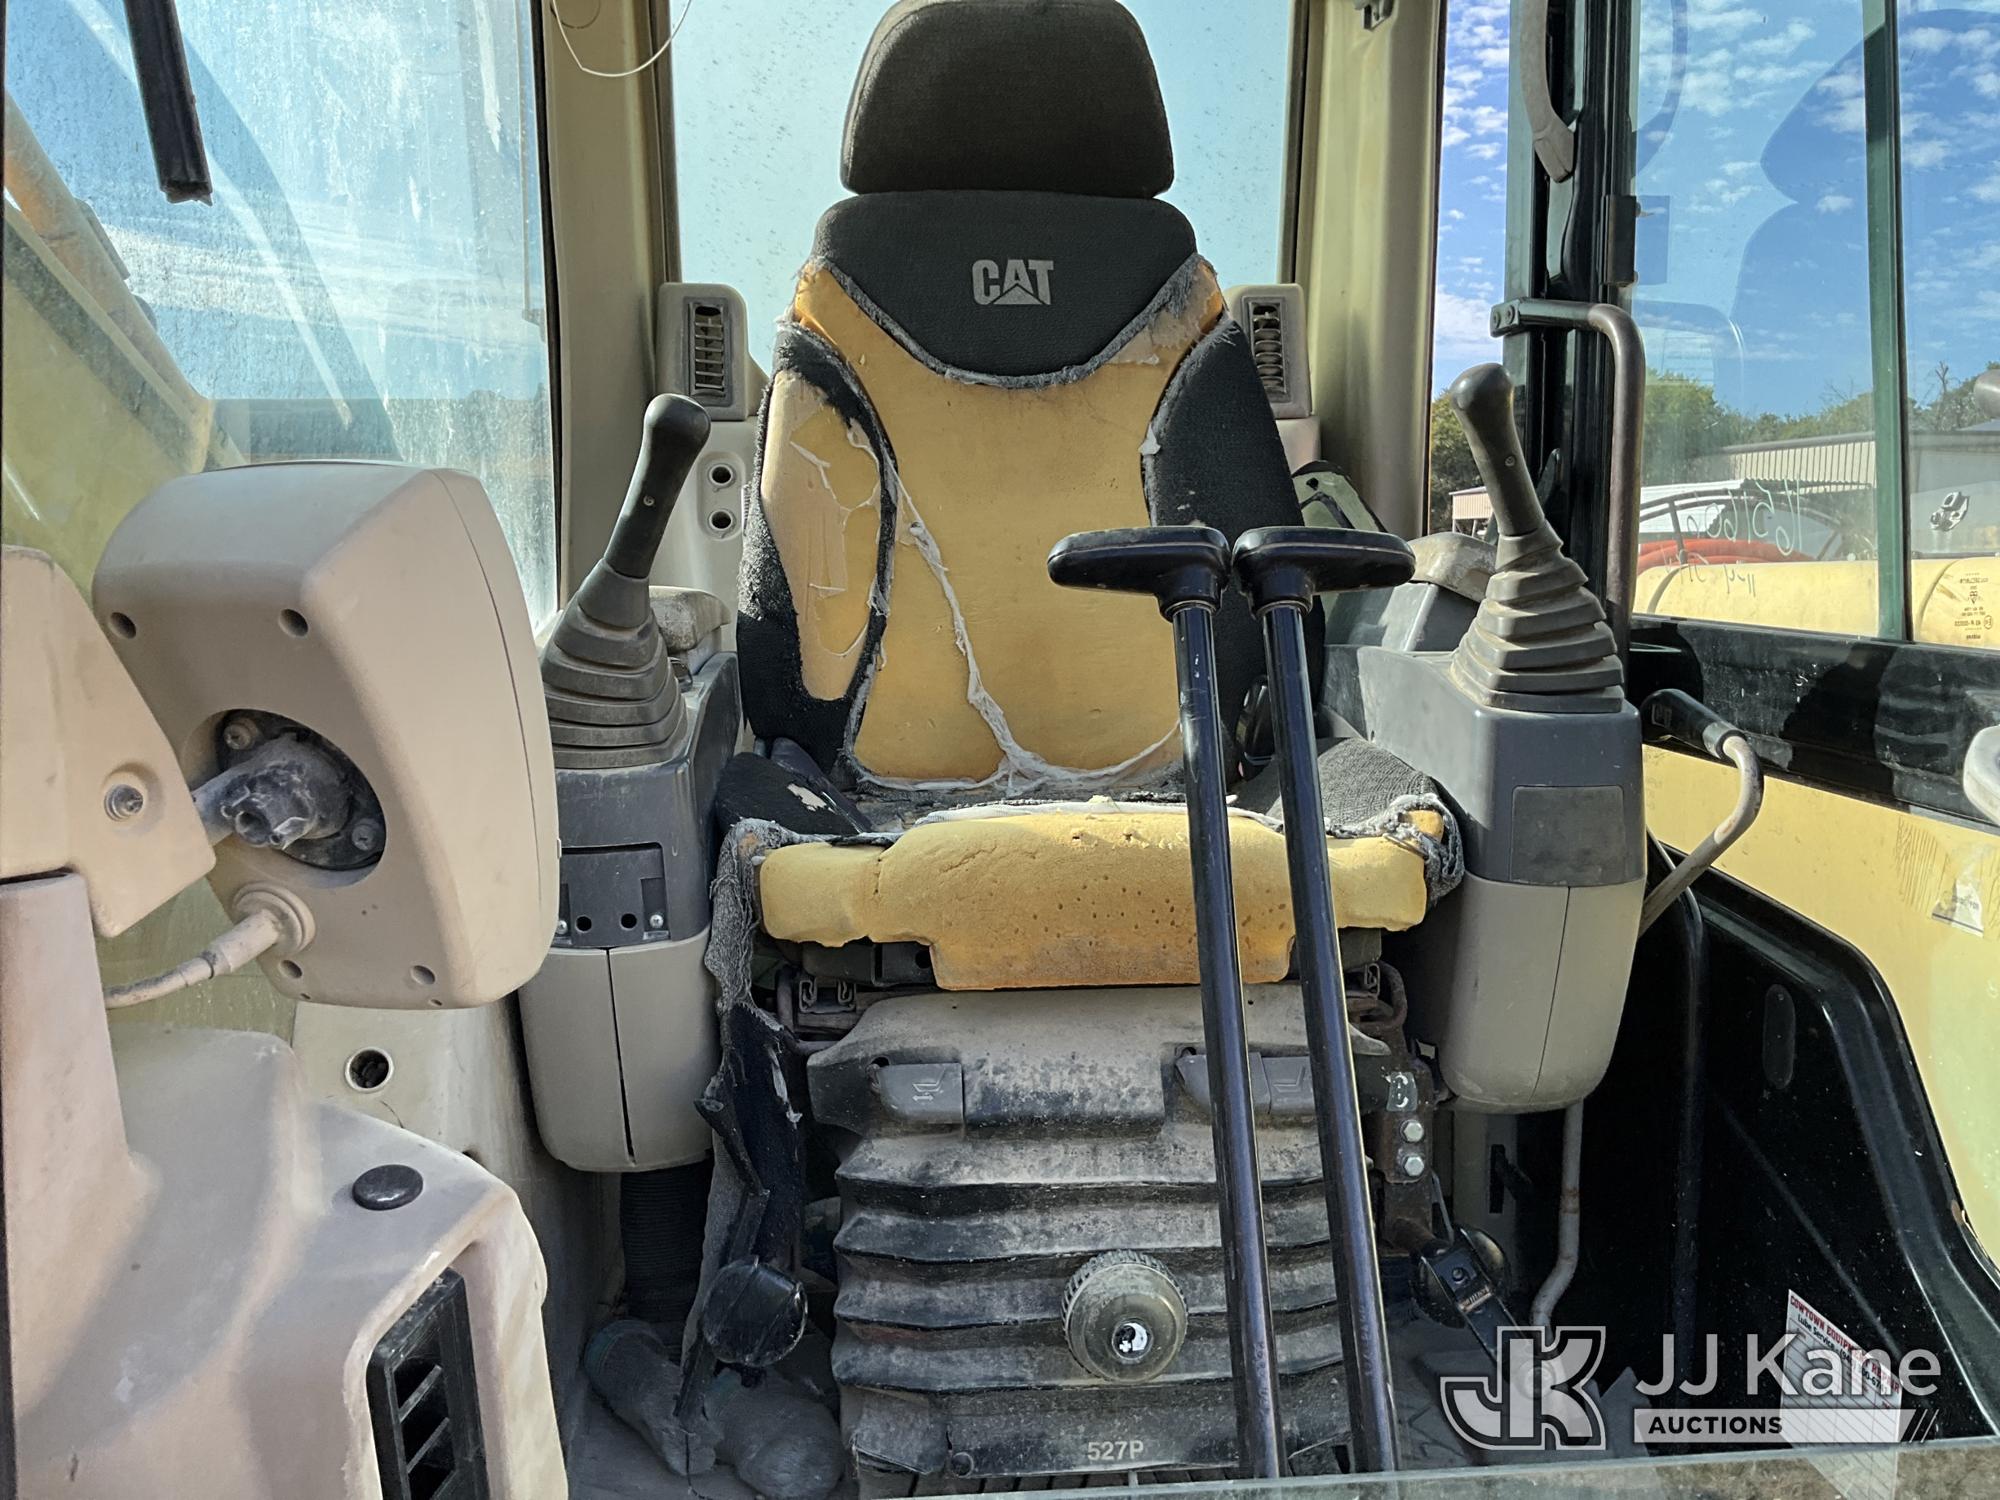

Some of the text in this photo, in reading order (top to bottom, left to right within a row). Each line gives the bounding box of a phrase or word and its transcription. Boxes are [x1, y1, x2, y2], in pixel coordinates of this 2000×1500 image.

[972, 259, 1054, 305] CAT
[1791, 1295, 1825, 1330] COWTOWN
[1798, 1313, 1811, 1332] Lube
[1813, 1326, 1835, 1350] Service
[1087, 1440, 1144, 1461] 527P
